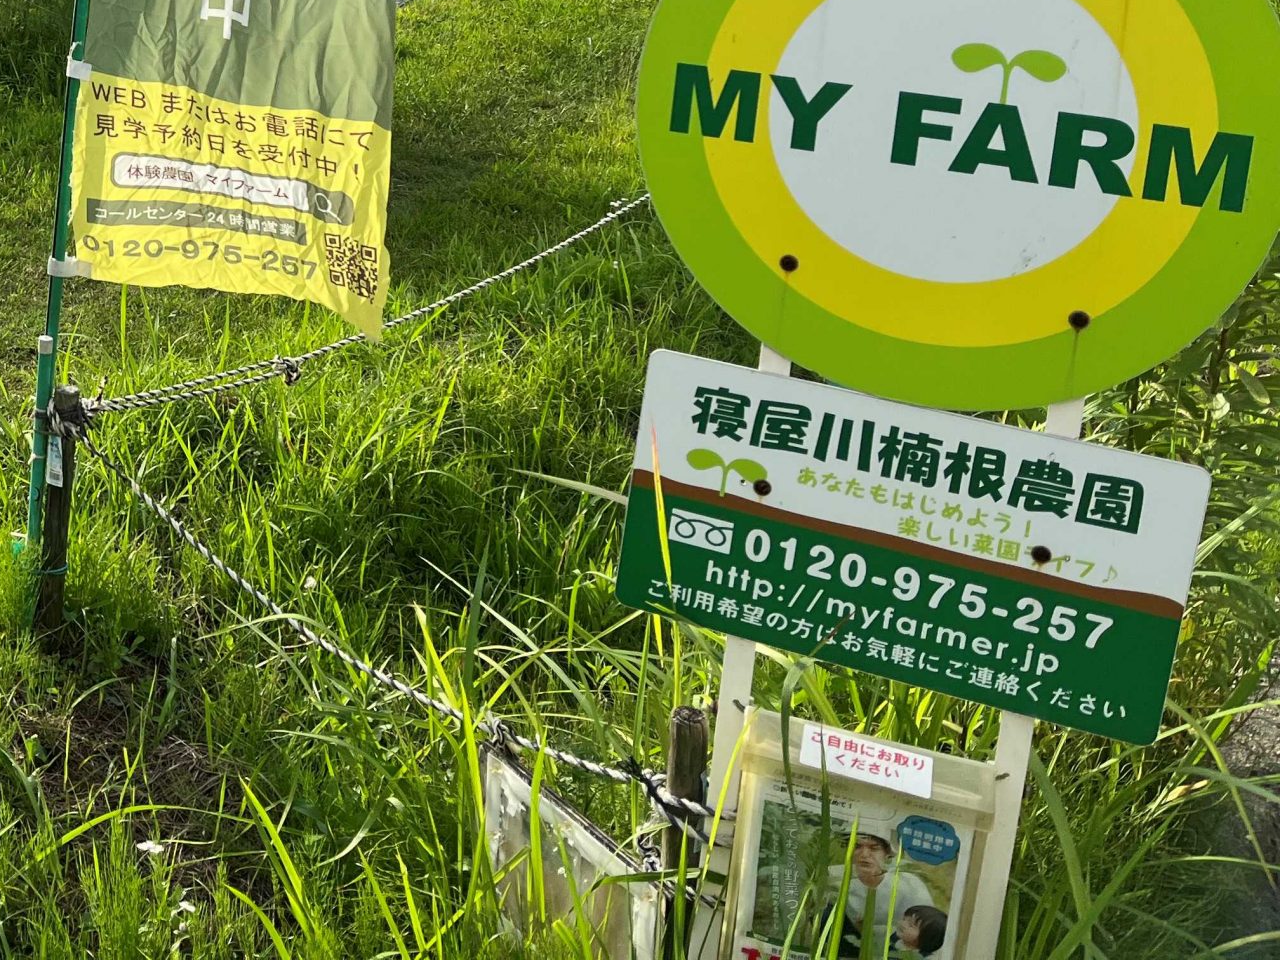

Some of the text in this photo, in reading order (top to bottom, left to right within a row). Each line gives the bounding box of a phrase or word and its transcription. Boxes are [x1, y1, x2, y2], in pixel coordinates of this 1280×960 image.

[91, 81, 373, 151] WEB またはお電話にて
[669, 62, 1255, 214] MY FARM
[128, 164, 289, 199] 体験農園 マイファーム
[83, 234, 318, 280] 0120-975-257
[691, 386, 1145, 535] 寝屋川楠根農園
[797, 466, 1031, 538] あなたもはじめよう！
[705, 560, 1059, 676] http://myfarmer.jp
[744, 528, 1114, 649] 0120-975-257
[648, 579, 1126, 719] ご利用希望の方はお気軽にご連絡ください
[811, 731, 925, 771] ご自由にお取り
[835, 754, 900, 778] ください
